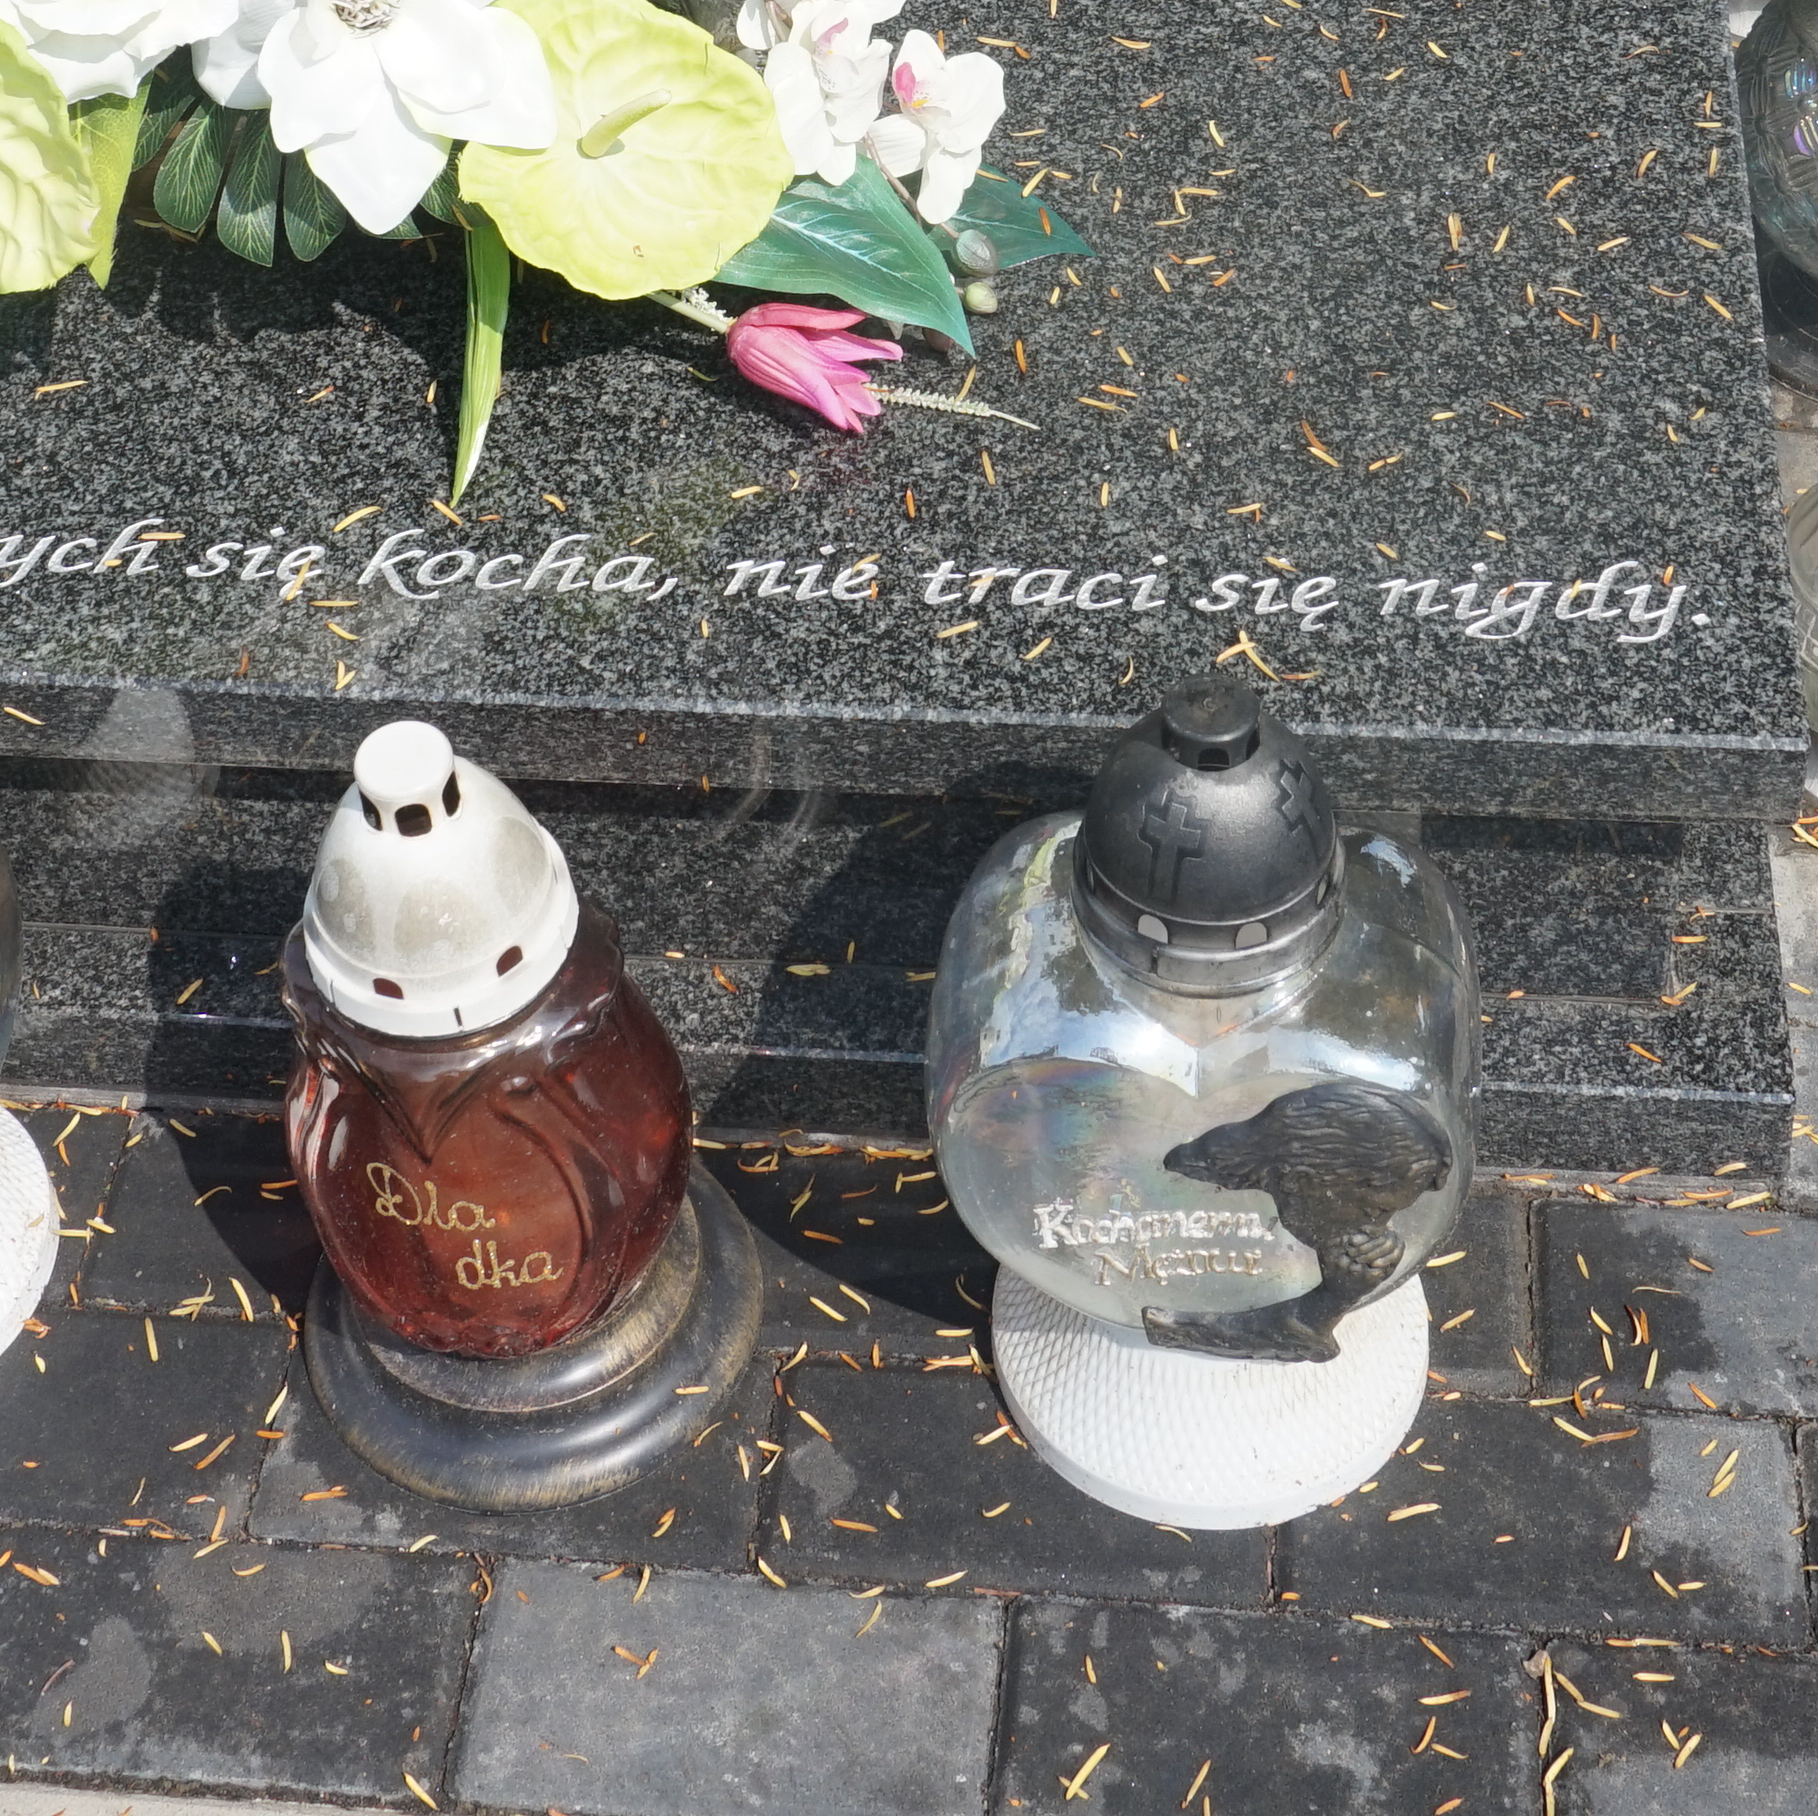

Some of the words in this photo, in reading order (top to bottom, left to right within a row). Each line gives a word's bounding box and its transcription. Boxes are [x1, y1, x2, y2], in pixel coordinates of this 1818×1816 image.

[185, 526, 327, 600] się
[357, 528, 679, 601] kocha,
[723, 544, 880, 601] nie
[922, 554, 1169, 611] traci
[1195, 557, 1340, 632] się
[1379, 560, 1712, 644] nigdy.
[366, 1161, 497, 1232] Dla
[454, 1238, 565, 1291] dka
